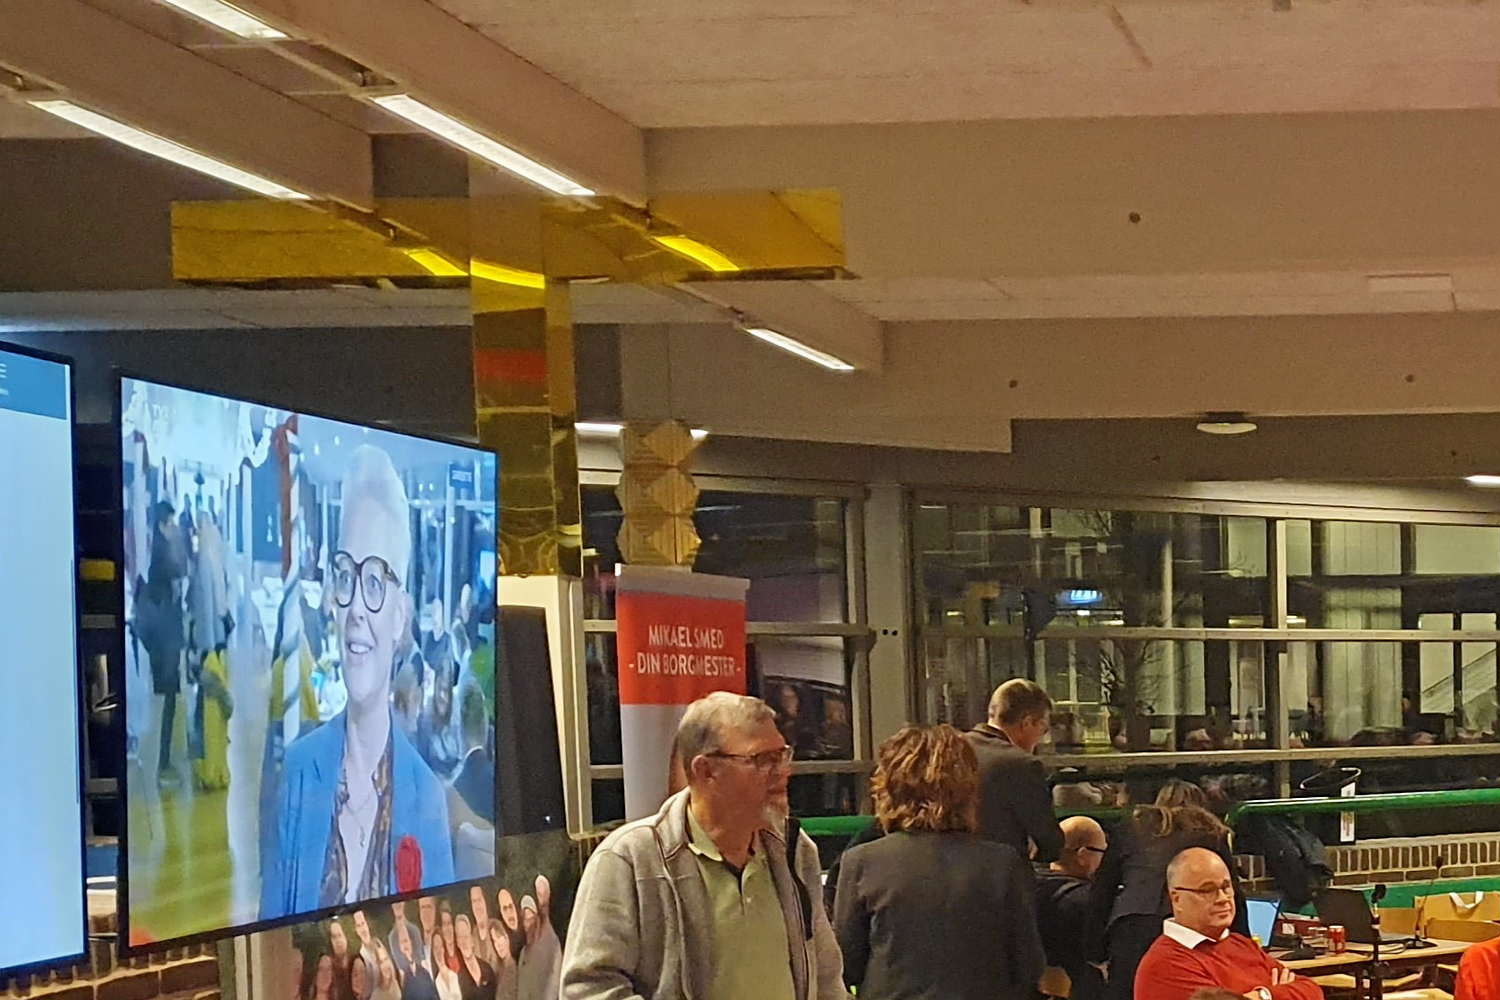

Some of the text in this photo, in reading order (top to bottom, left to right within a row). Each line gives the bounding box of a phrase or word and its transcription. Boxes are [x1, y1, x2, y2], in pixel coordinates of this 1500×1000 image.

[649, 625, 724, 649] MIKAEL SMED
[637, 652, 660, 674] DIN
[663, 653, 735, 677] BORGMESTER
